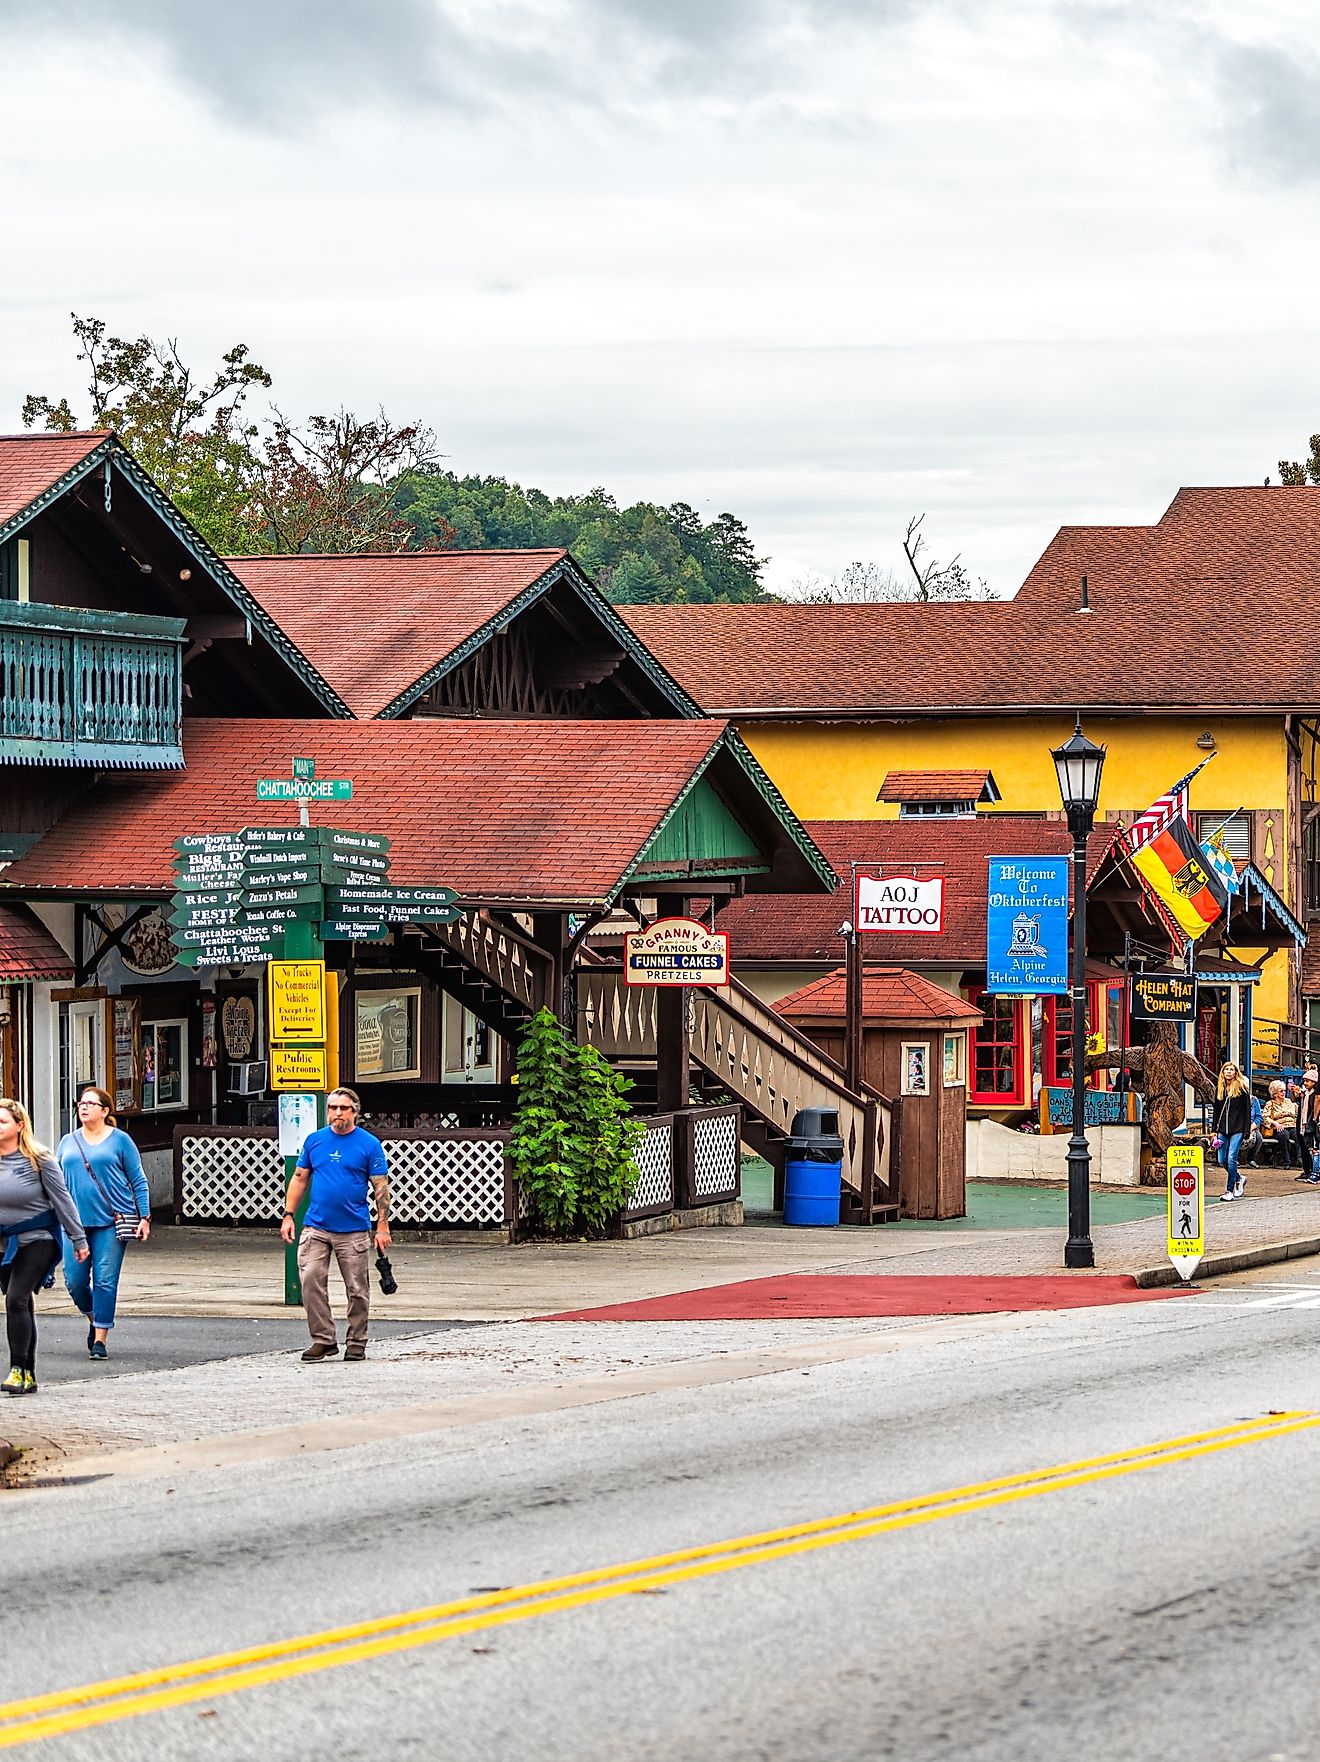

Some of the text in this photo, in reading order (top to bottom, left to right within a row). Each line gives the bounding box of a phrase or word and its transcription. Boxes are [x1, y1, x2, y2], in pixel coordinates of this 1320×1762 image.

[260, 782, 333, 796] CHATTAHOOCHEE
[183, 835, 231, 846] Cowboys
[267, 831, 286, 842] Bakery
[333, 834, 380, 848] Christmas & More
[188, 854, 222, 866] Bigg
[273, 853, 287, 862] Dutch
[189, 863, 244, 873] RESTAURANT
[371, 859, 386, 869] Photo
[182, 873, 223, 882] Muller's
[249, 871, 308, 886] Marley's Vape Shop
[365, 873, 380, 882] Cream
[999, 865, 1057, 881] Welcome
[200, 881, 235, 889] Cheese
[1018, 879, 1038, 893] To
[185, 894, 218, 905] Rice
[249, 889, 298, 903] Zuzu's Petals
[339, 889, 446, 900] Homemade Ice Cream
[990, 892, 1066, 907] Oktoberfest
[246, 911, 265, 921] Yonah
[265, 910, 286, 920] Coffee
[287, 909, 297, 918] Co.
[342, 904, 450, 915] Fast Food, Funnel Cakes
[388, 913, 410, 921] Fries
[861, 907, 939, 924] TATTOO
[188, 919, 209, 927] HOME
[335, 923, 380, 932] Alpine Dispensary
[184, 924, 285, 940] Chattahoochee St.
[348, 930, 368, 939] Express
[200, 934, 270, 946] Leather Works
[645, 928, 711, 950] GRANNY'S
[205, 945, 260, 957] Livi Lous
[658, 945, 698, 953] FAMOUS
[196, 955, 231, 965] Sweets
[241, 952, 273, 962] Treats
[635, 956, 718, 968] FUNNEL CAKES
[1010, 958, 1046, 974] Alpine
[282, 967, 312, 977] No Trucks
[647, 970, 702, 980] PRETZELS
[990, 971, 1067, 987] Helen, Georgia
[275, 980, 319, 990] No Commercial
[1135, 980, 1194, 998] HELEN HAT
[286, 993, 309, 1003] Vehicles
[1143, 996, 1188, 1013] COMPANY
[279, 1006, 316, 1015] Except For
[225, 1021, 251, 1039] Pretzel
[228, 1039, 246, 1054] Haus
[284, 1053, 313, 1063] Public
[276, 1065, 321, 1073] Restrooms
[1174, 1180, 1194, 1188] STOP
